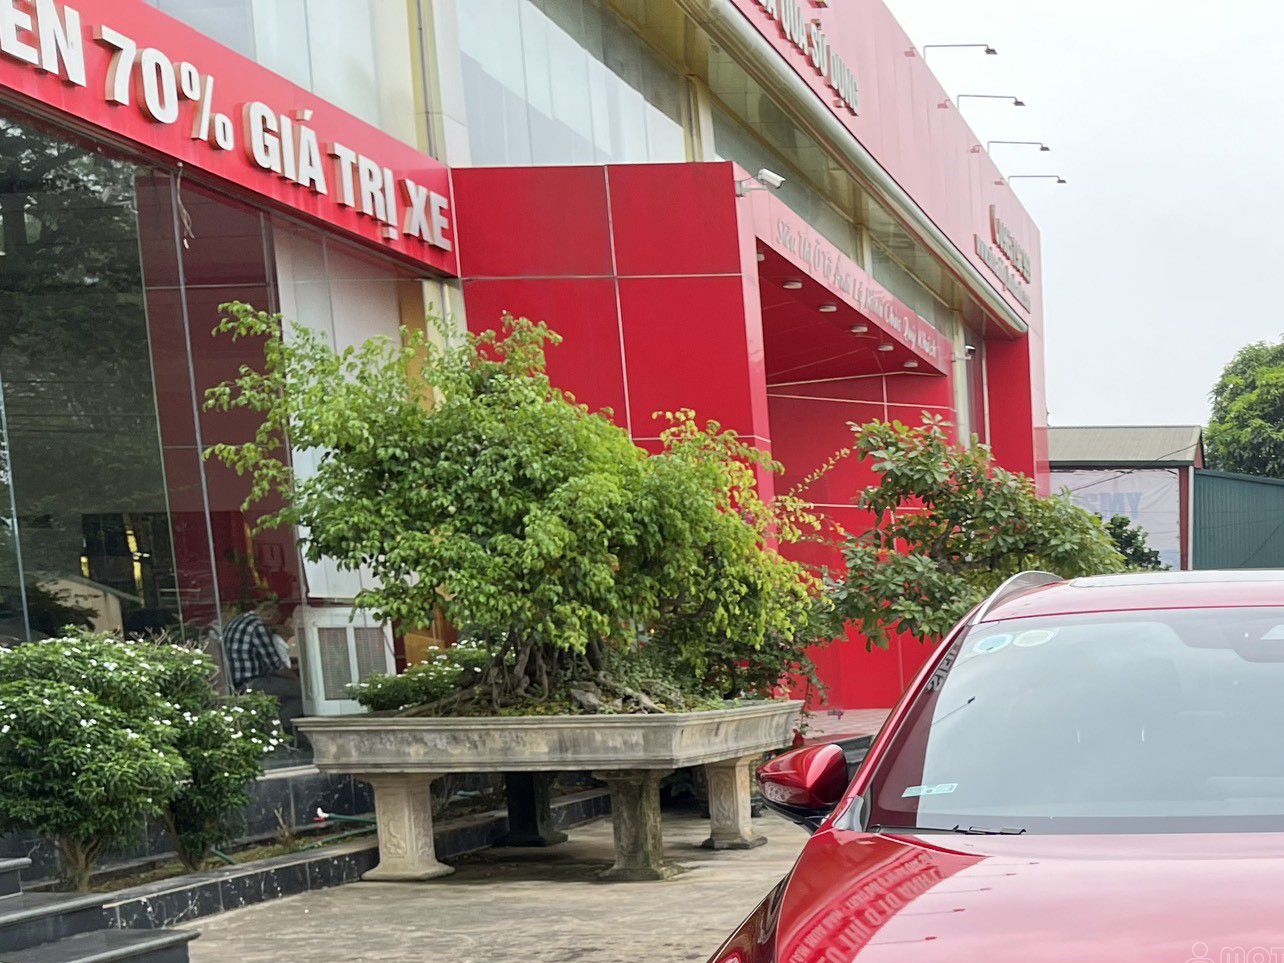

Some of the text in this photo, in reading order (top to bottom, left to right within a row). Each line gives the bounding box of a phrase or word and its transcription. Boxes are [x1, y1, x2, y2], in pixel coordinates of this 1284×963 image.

[94, 24, 235, 151] 70%
[244, 101, 328, 195] GIÁ
[329, 142, 399, 240] TRỊ
[404, 178, 452, 252] XE
